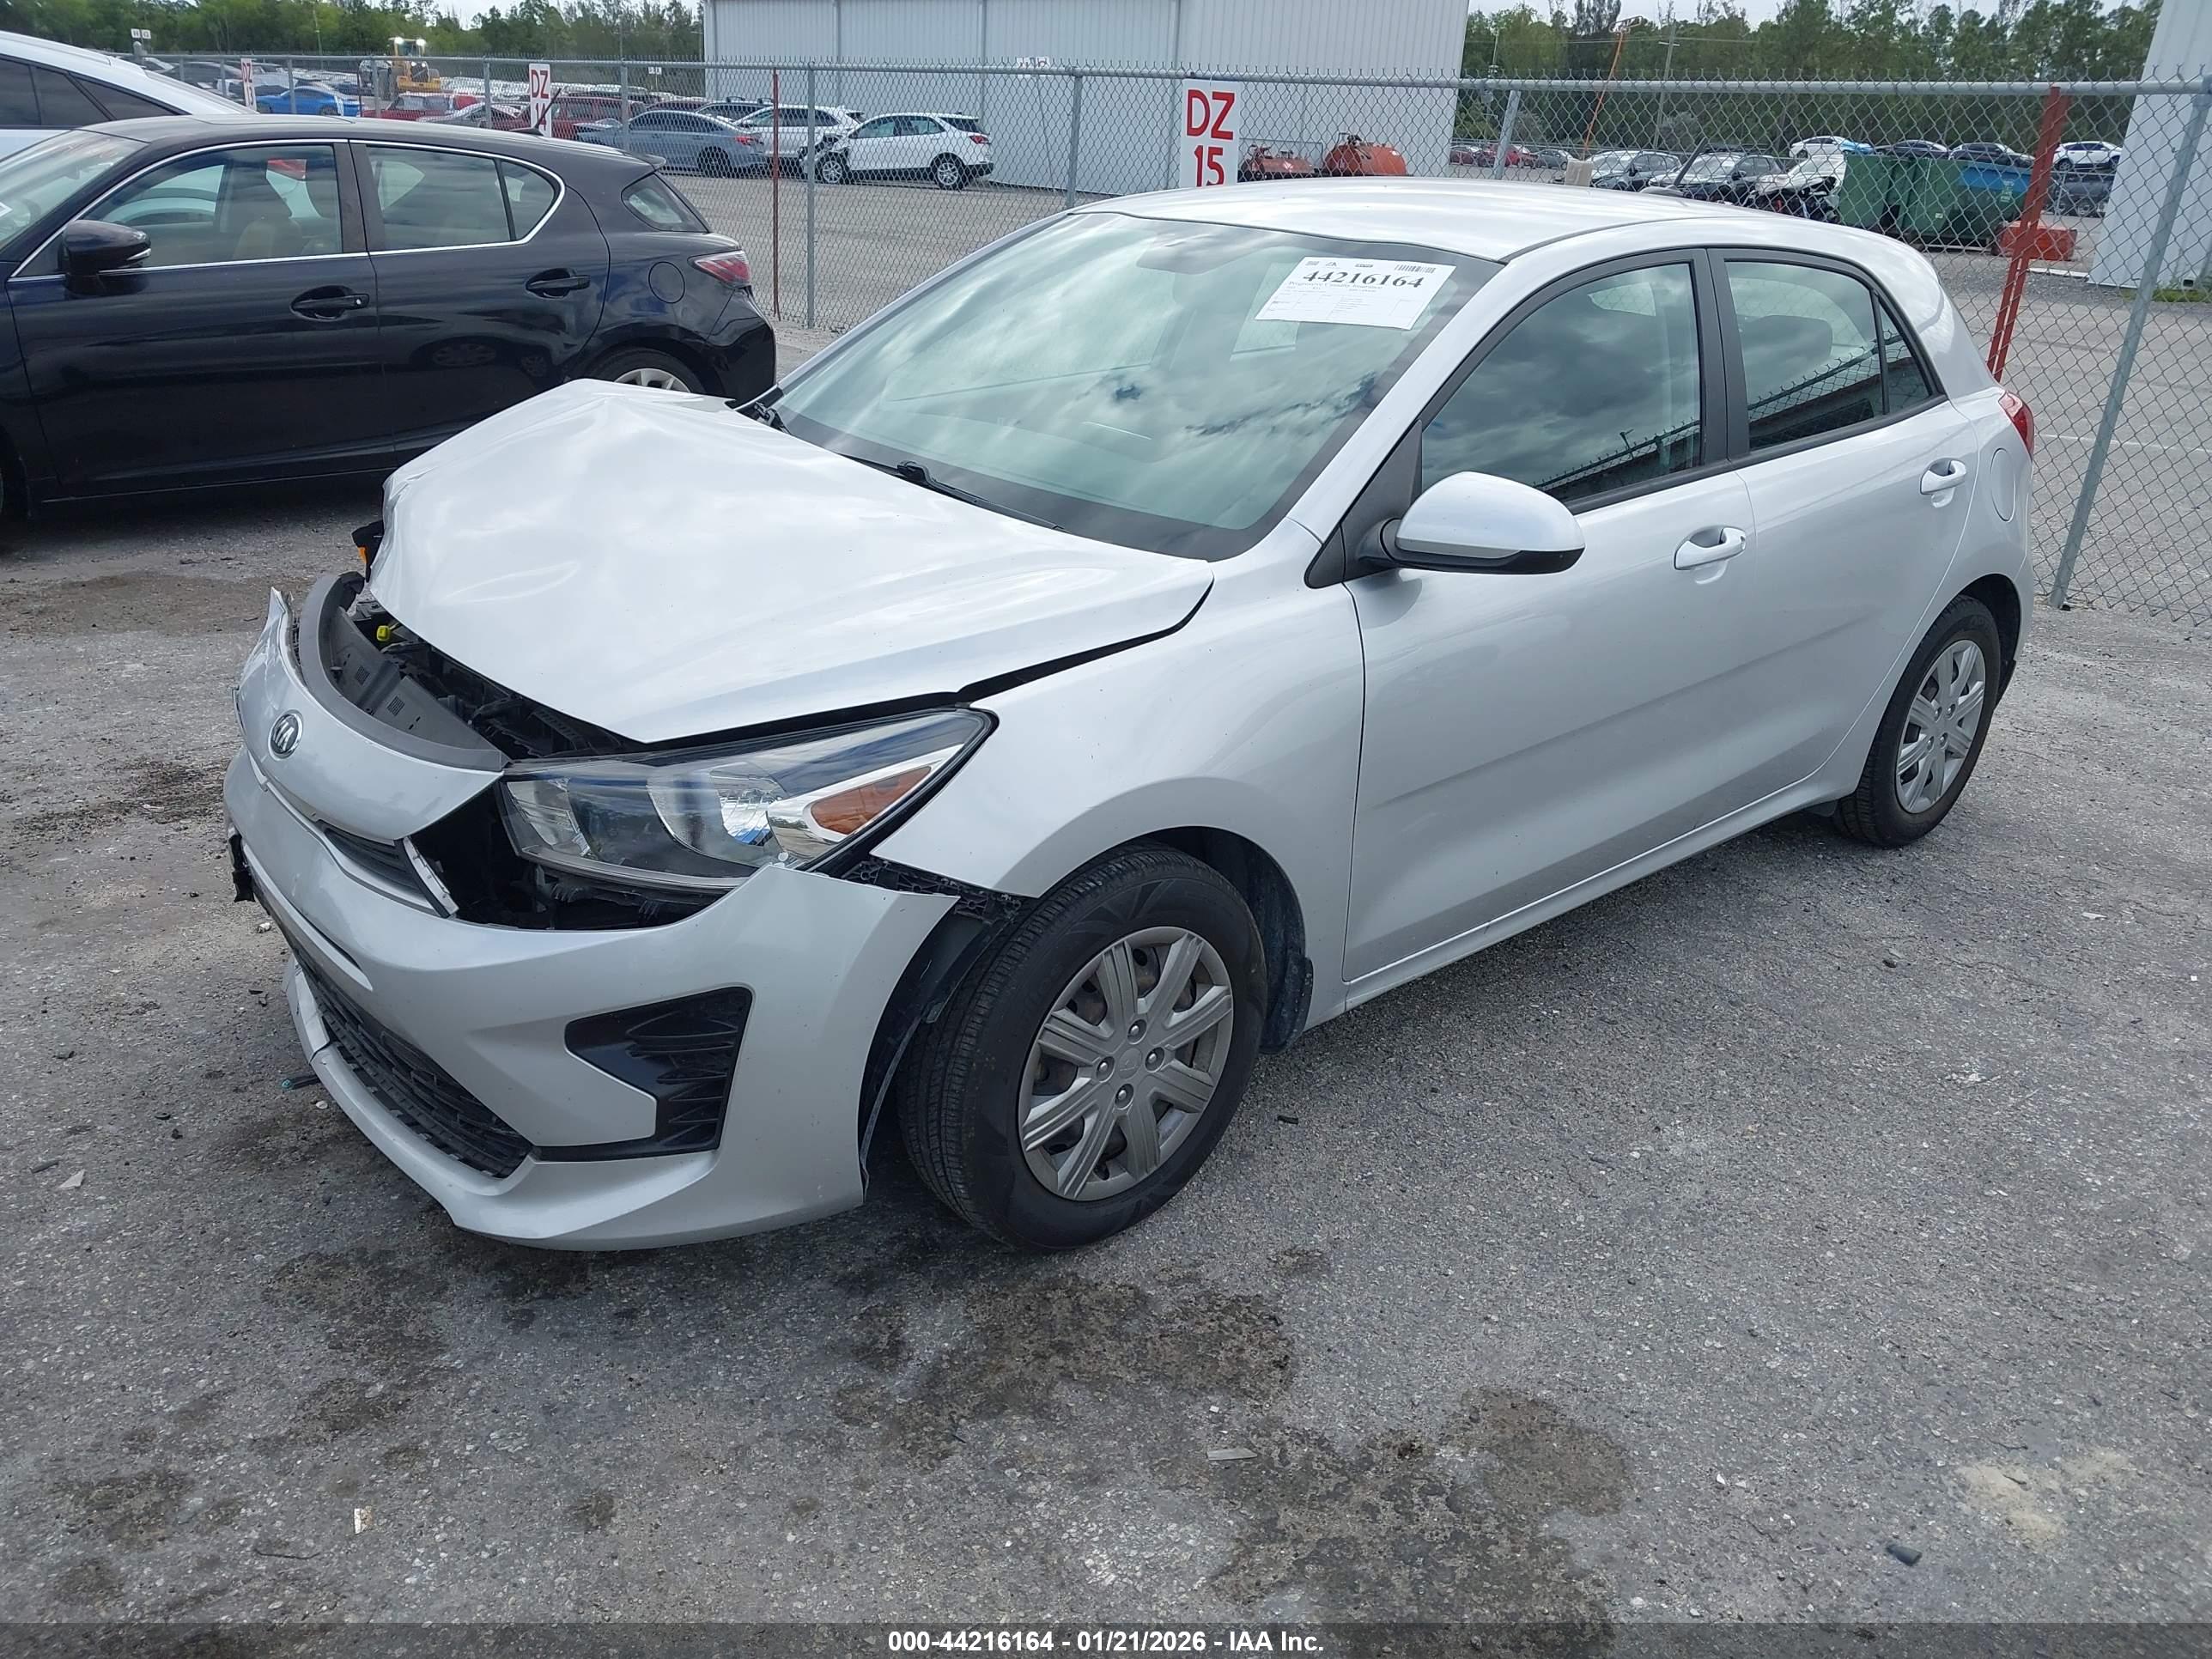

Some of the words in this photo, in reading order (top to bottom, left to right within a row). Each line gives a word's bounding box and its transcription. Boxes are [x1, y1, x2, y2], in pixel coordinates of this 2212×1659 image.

[242, 62, 252, 83] DZ
[531, 70, 550, 99] DZ
[1187, 89, 1235, 141] DZ
[1194, 144, 1224, 187] 15
[1303, 270, 1425, 289] 44216164
